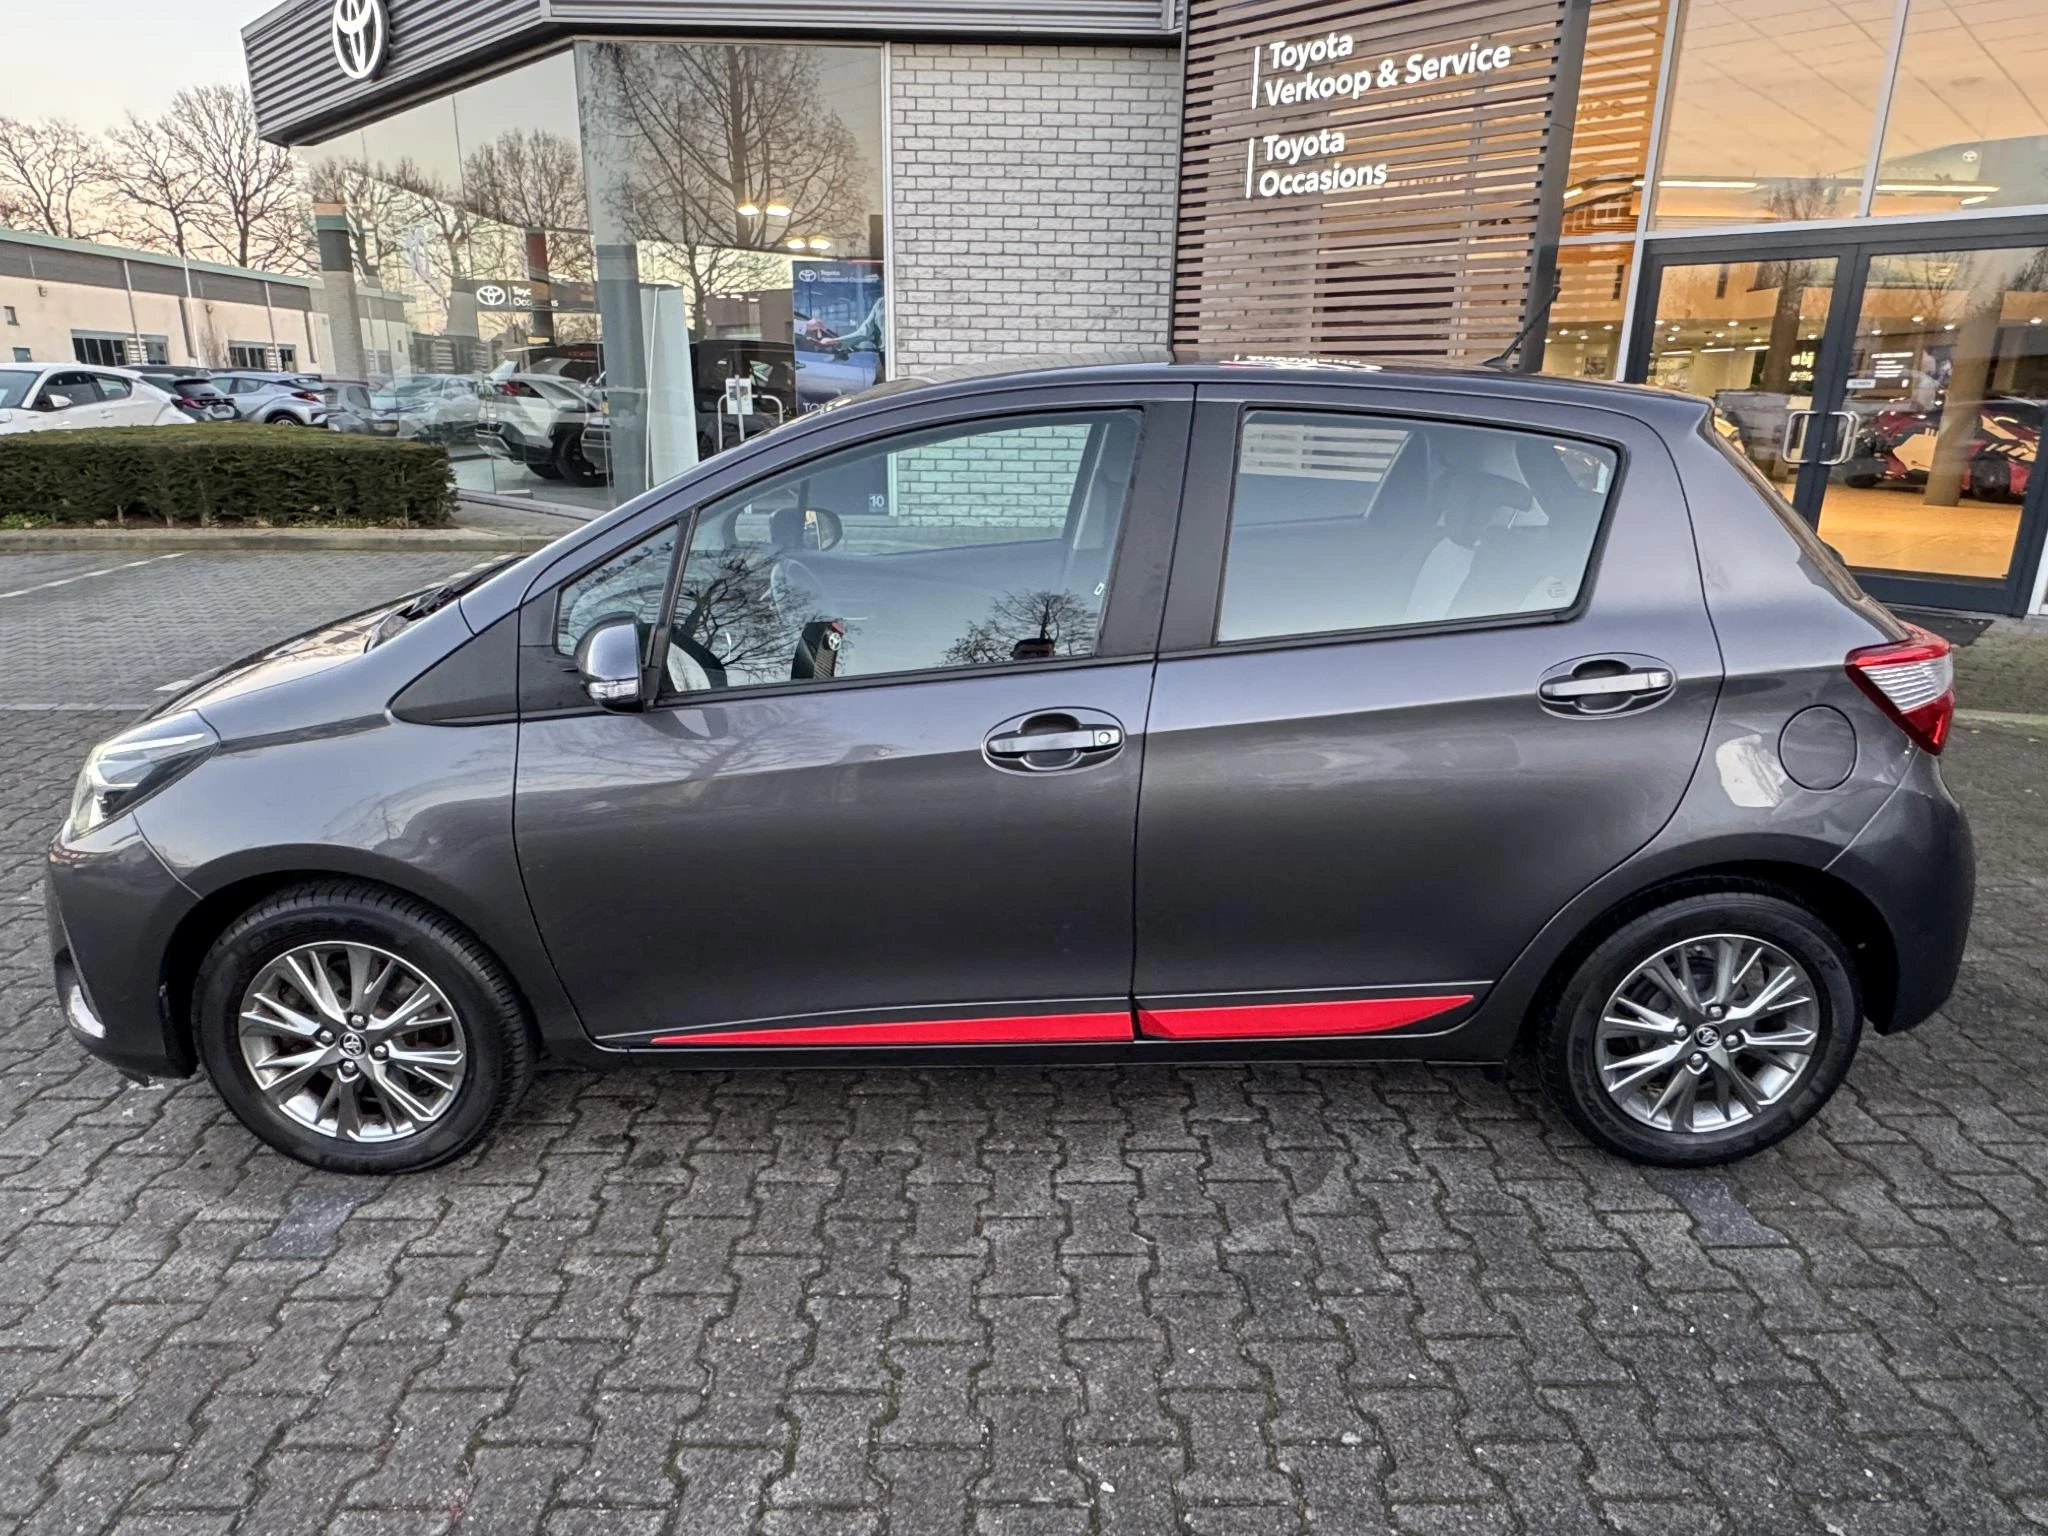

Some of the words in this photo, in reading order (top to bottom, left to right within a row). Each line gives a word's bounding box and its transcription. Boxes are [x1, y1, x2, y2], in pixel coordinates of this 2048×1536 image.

[1269, 32, 1353, 71] Toyota
[1264, 72, 1372, 106] Verkoop
[1376, 59, 1398, 88] &
[1404, 43, 1512, 84] Service
[1263, 129, 1346, 165] Toyota
[1259, 161, 1388, 197] Occasions
[869, 495, 885, 508] 10
